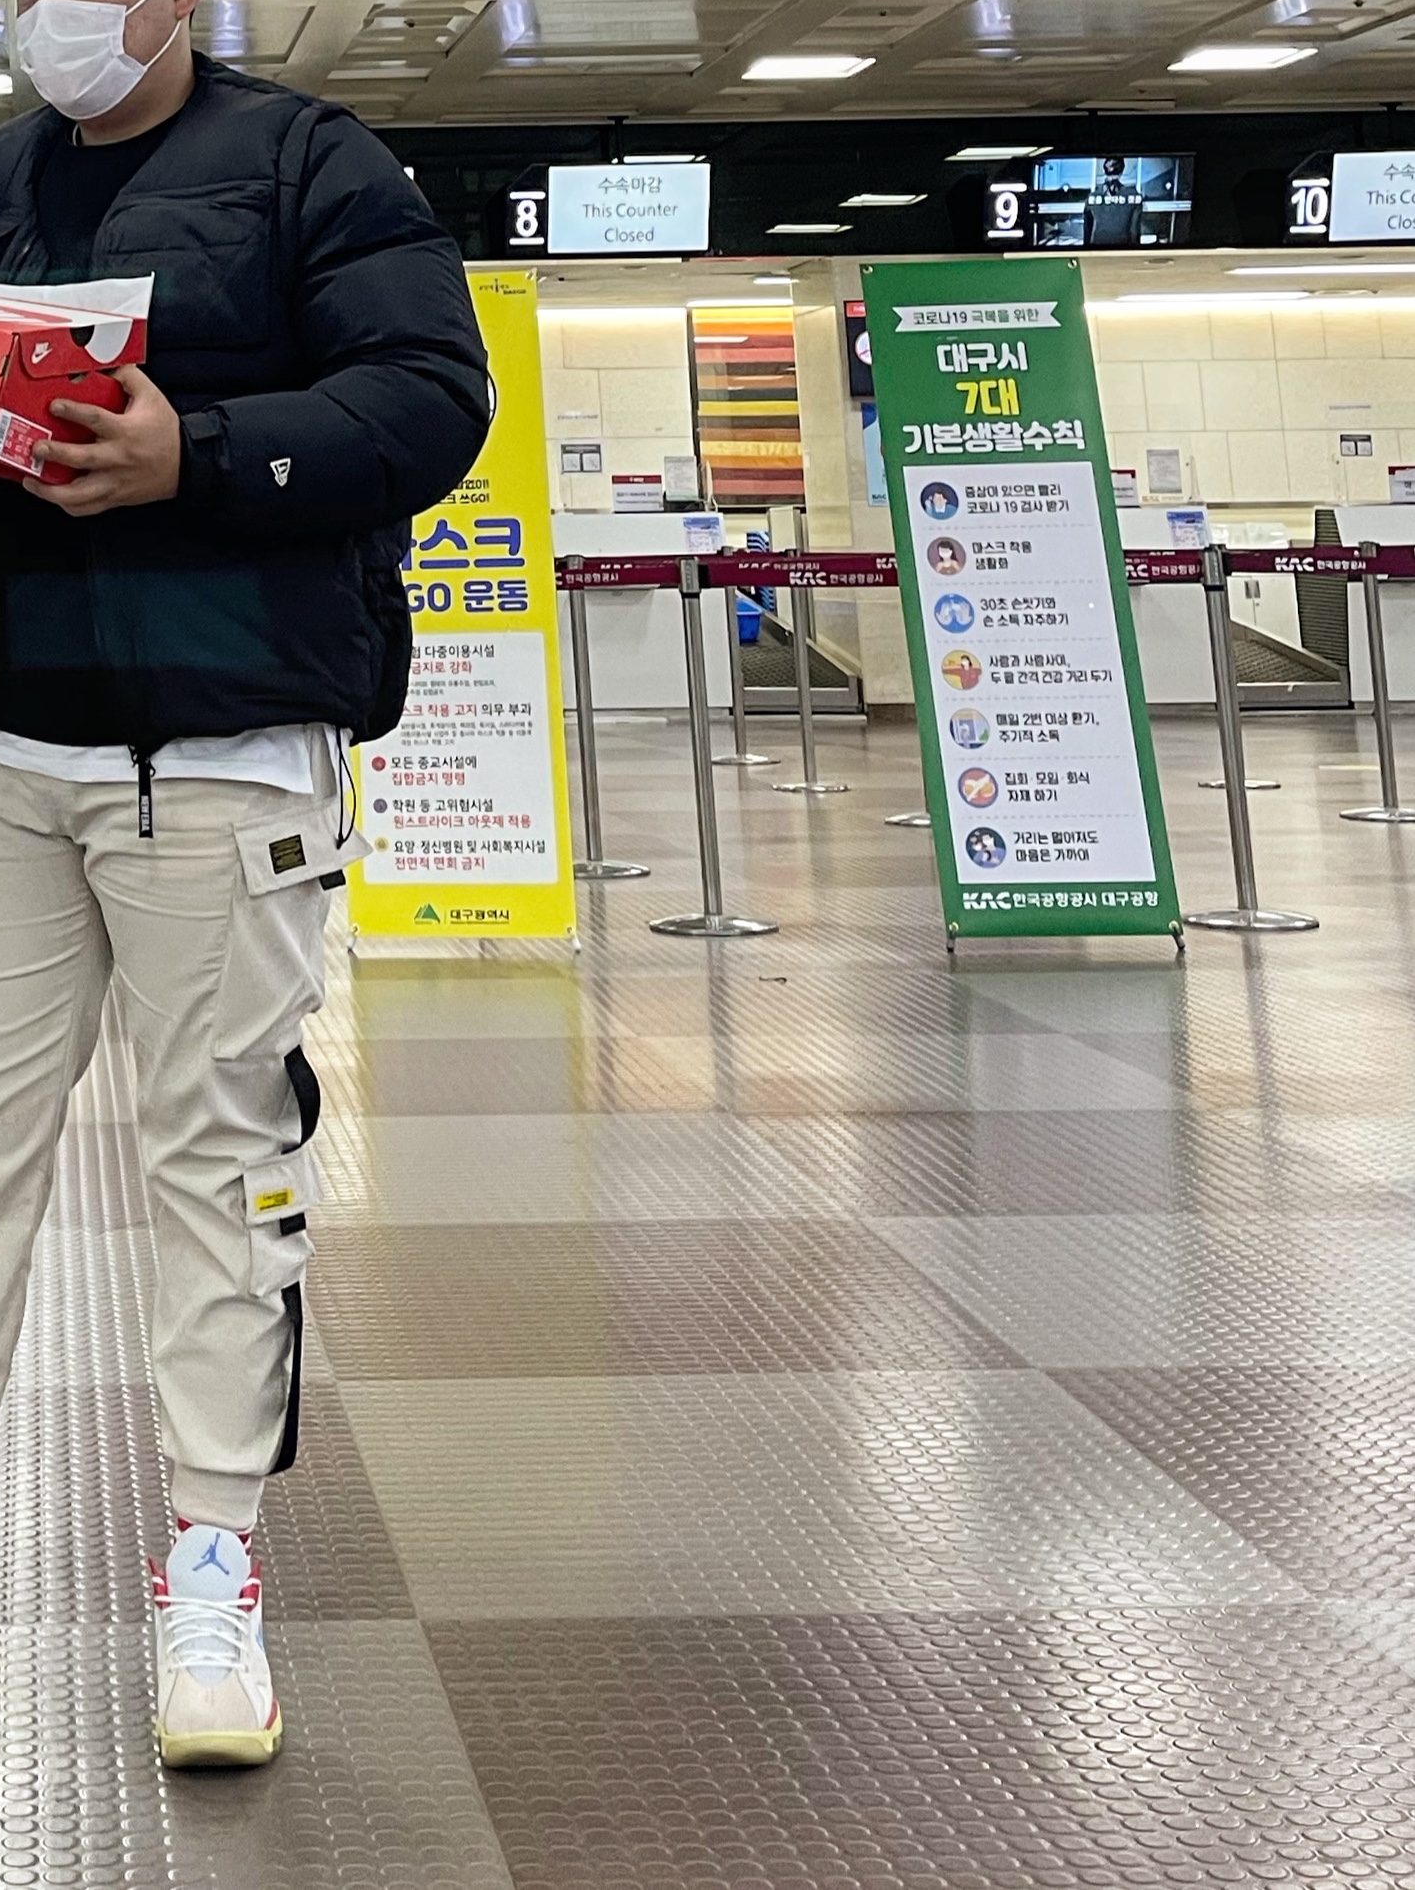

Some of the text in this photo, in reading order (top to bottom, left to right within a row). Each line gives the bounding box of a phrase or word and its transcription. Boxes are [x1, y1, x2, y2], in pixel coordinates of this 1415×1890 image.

[597, 175, 663, 194] 수속마감
[1366, 189, 1396, 205] This
[582, 202, 678, 218] This Counter
[995, 191, 1019, 229] 9
[1291, 187, 1329, 226] 10
[515, 199, 539, 237] 8
[604, 226, 655, 242] Closed
[913, 308, 1040, 325] 코로나19 극복을 위한
[936, 341, 1029, 373] 대구시
[955, 378, 1020, 416] 7대
[902, 419, 1086, 454] 기본생활수칙
[964, 484, 1062, 498] 증상이 있으면 빨리
[967, 500, 1069, 514] 코로나 19 검사 받기
[972, 541, 1032, 554] 마스크 착용
[975, 557, 1009, 570] 생활화
[1125, 563, 1149, 578] AC
[1275, 556, 1367, 572] KAC 한국공항공사
[565, 572, 619, 584] 한국공항공사
[789, 571, 884, 585] KAC 한국공항공사
[462, 579, 529, 613] 운동
[980, 597, 1056, 611] 30초 손씻기와
[983, 613, 1069, 627] 손 소독 자주하기
[424, 644, 495, 659] 다중이용시설
[411, 661, 473, 675] 금지로 강화
[989, 654, 1071, 668] 사람과 사람사이,
[991, 670, 1112, 685] 두 팔 간격 건강 거리 두기
[454, 704, 477, 717] 고지
[481, 703, 505, 716] 의무
[508, 703, 532, 716] 부과
[996, 714, 1019, 726] 매일
[1022, 713, 1042, 726] 2번
[1045, 713, 1068, 726] 이상
[999, 730, 1060, 743] 주기적 소독
[391, 756, 477, 769] 모든 종교시설에
[391, 772, 466, 785] 집합금지 명령
[1005, 771, 1090, 785] 집회 모임 회식
[1007, 789, 1058, 802] 자제 하기
[392, 799, 494, 813] 학원 등 고위험시설
[393, 815, 532, 829] 원스트라이크 아웃제 적용
[1013, 831, 1048, 844] 거리는
[468, 840, 478, 853] 및
[480, 839, 546, 854] 사회복지시설
[1015, 848, 1090, 862] 마음은 가까이
[395, 856, 485, 871] 전면적 면회 금지
[963, 890, 1159, 910] KAC 한국공항공사 대구공항
[450, 909, 510, 921] 대구광역시
